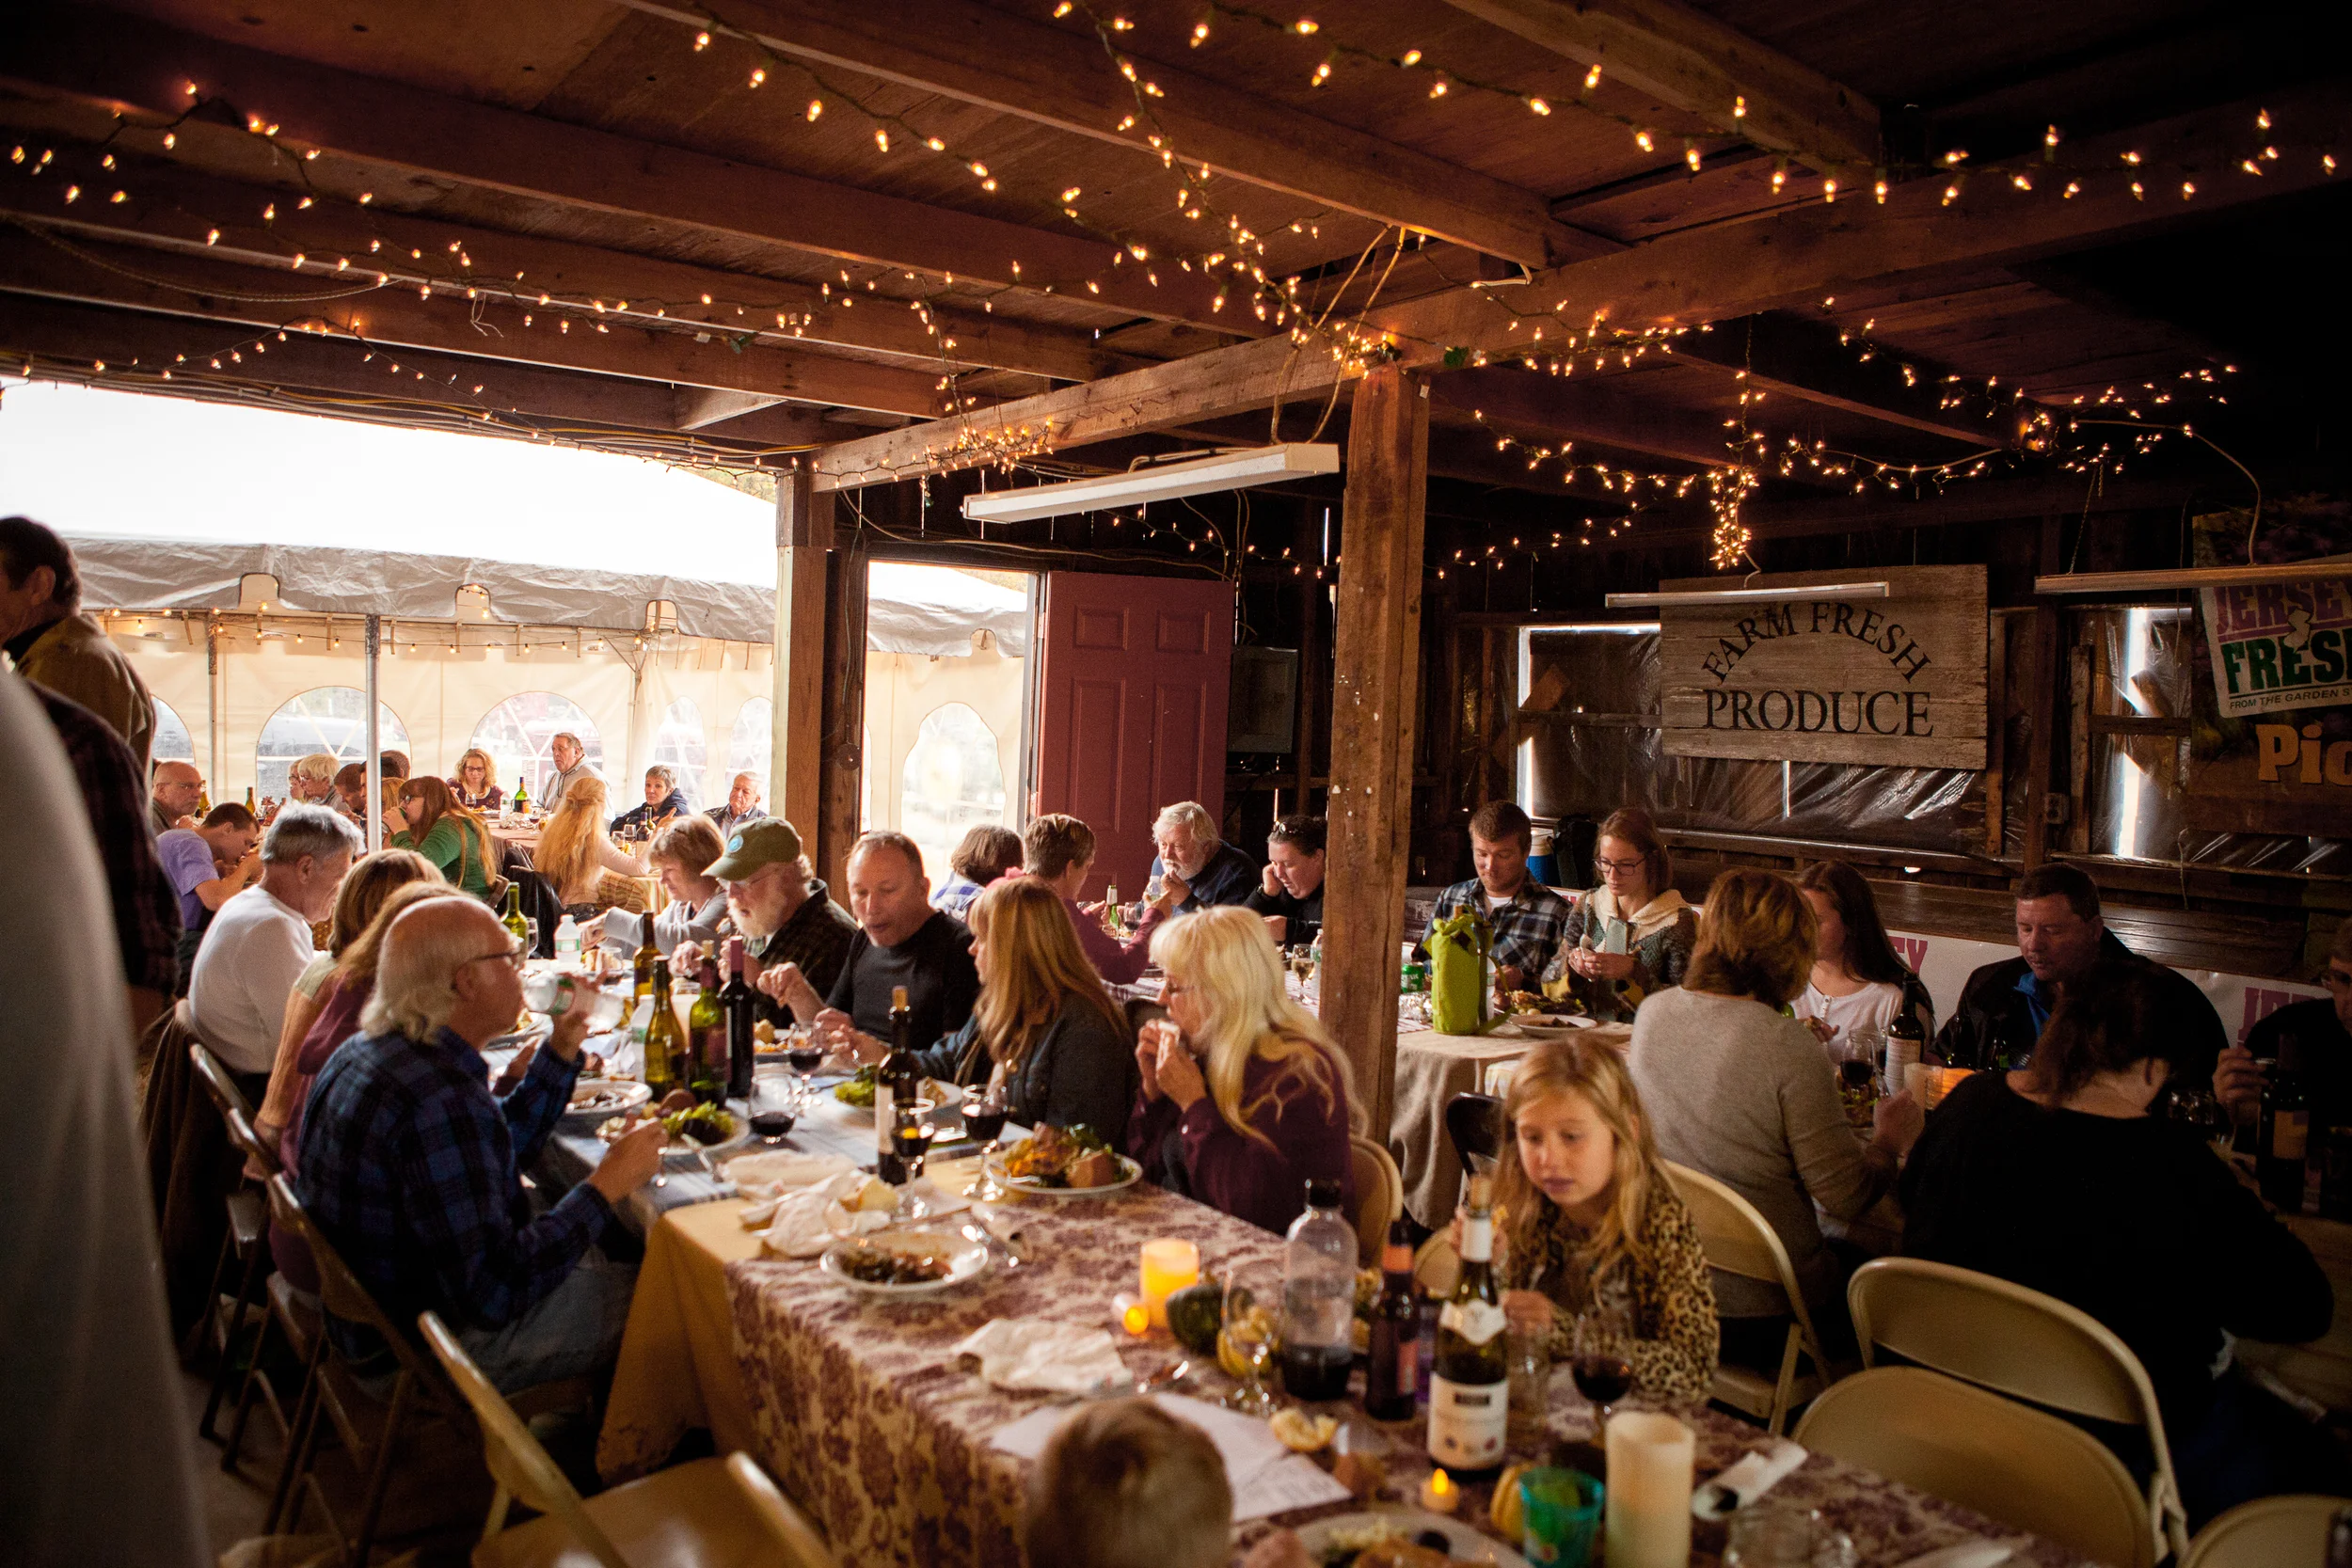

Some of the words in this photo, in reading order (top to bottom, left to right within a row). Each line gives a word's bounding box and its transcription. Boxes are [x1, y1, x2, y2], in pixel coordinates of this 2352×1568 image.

[2214, 579, 2352, 635] JERSE
[1701, 602, 1800, 686] FARM
[1809, 602, 1931, 684] FRESH
[2221, 628, 2352, 694] FRES
[1703, 689, 1934, 737] PRODUCE
[2230, 699, 2257, 710] FROM
[2260, 695, 2282, 706] THE
[2284, 689, 2339, 703] GARDEN
